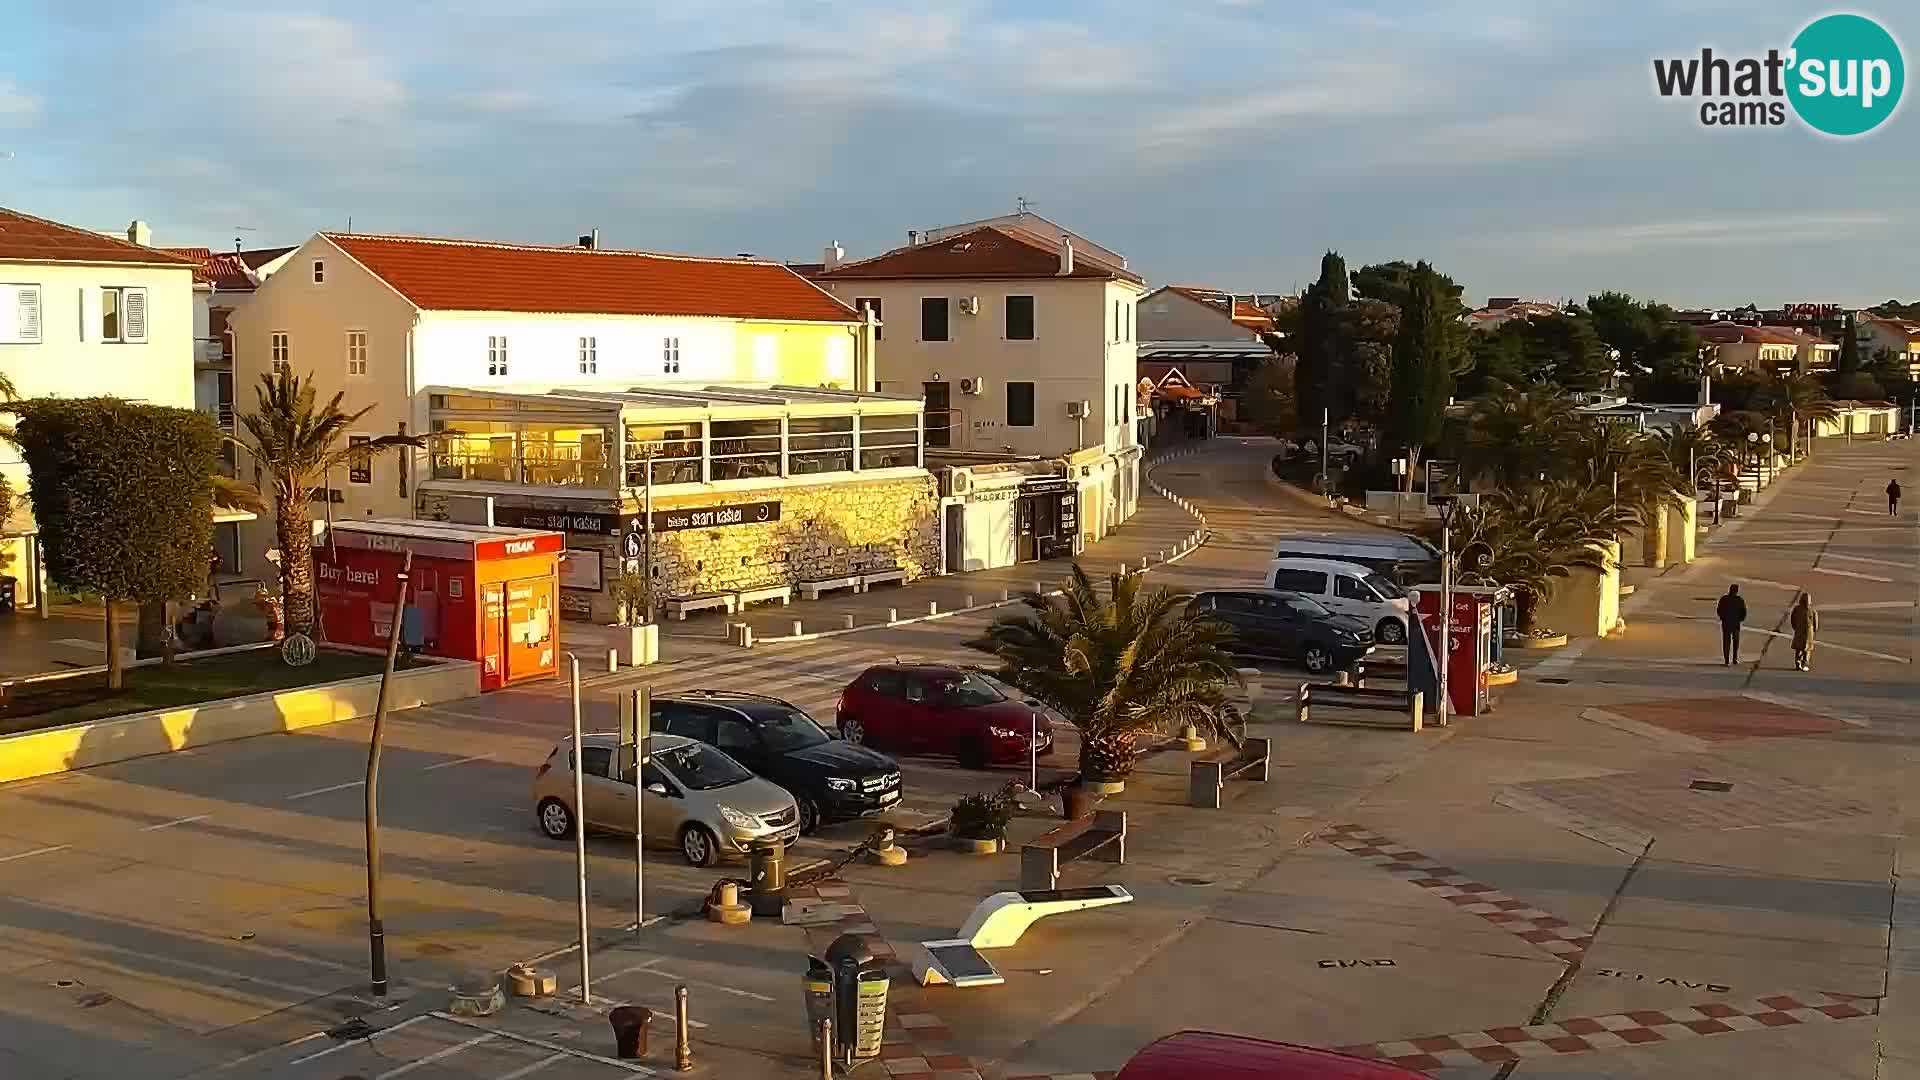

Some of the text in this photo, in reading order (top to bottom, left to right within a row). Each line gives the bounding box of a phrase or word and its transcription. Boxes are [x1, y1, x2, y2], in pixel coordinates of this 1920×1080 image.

[691, 511, 714, 526] stari
[504, 541, 536, 555] TISAK
[319, 562, 379, 585] Buy here!
